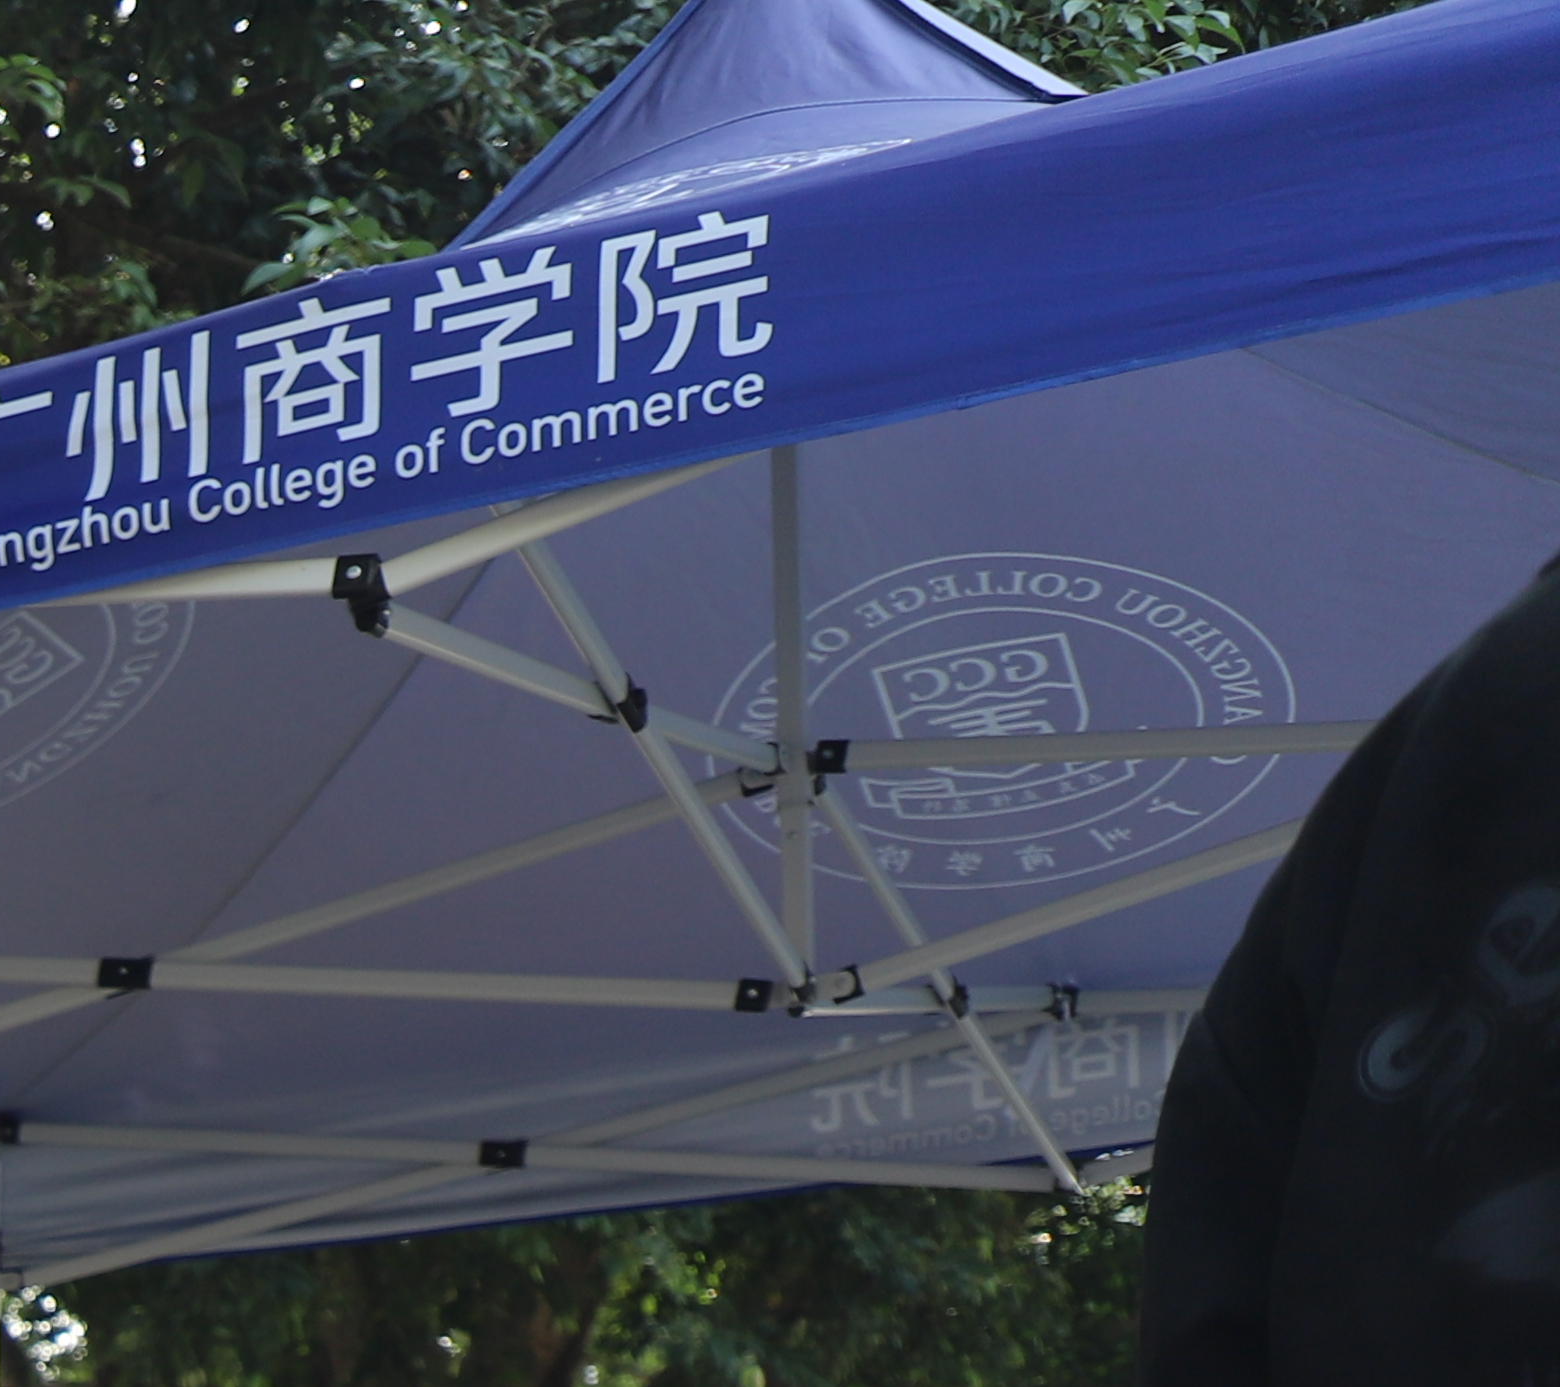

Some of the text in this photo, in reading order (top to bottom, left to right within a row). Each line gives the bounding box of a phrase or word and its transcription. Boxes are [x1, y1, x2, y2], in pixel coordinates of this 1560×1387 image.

[188, 448, 377, 524] College
[394, 428, 444, 479] of
[460, 371, 766, 465] Commerce
